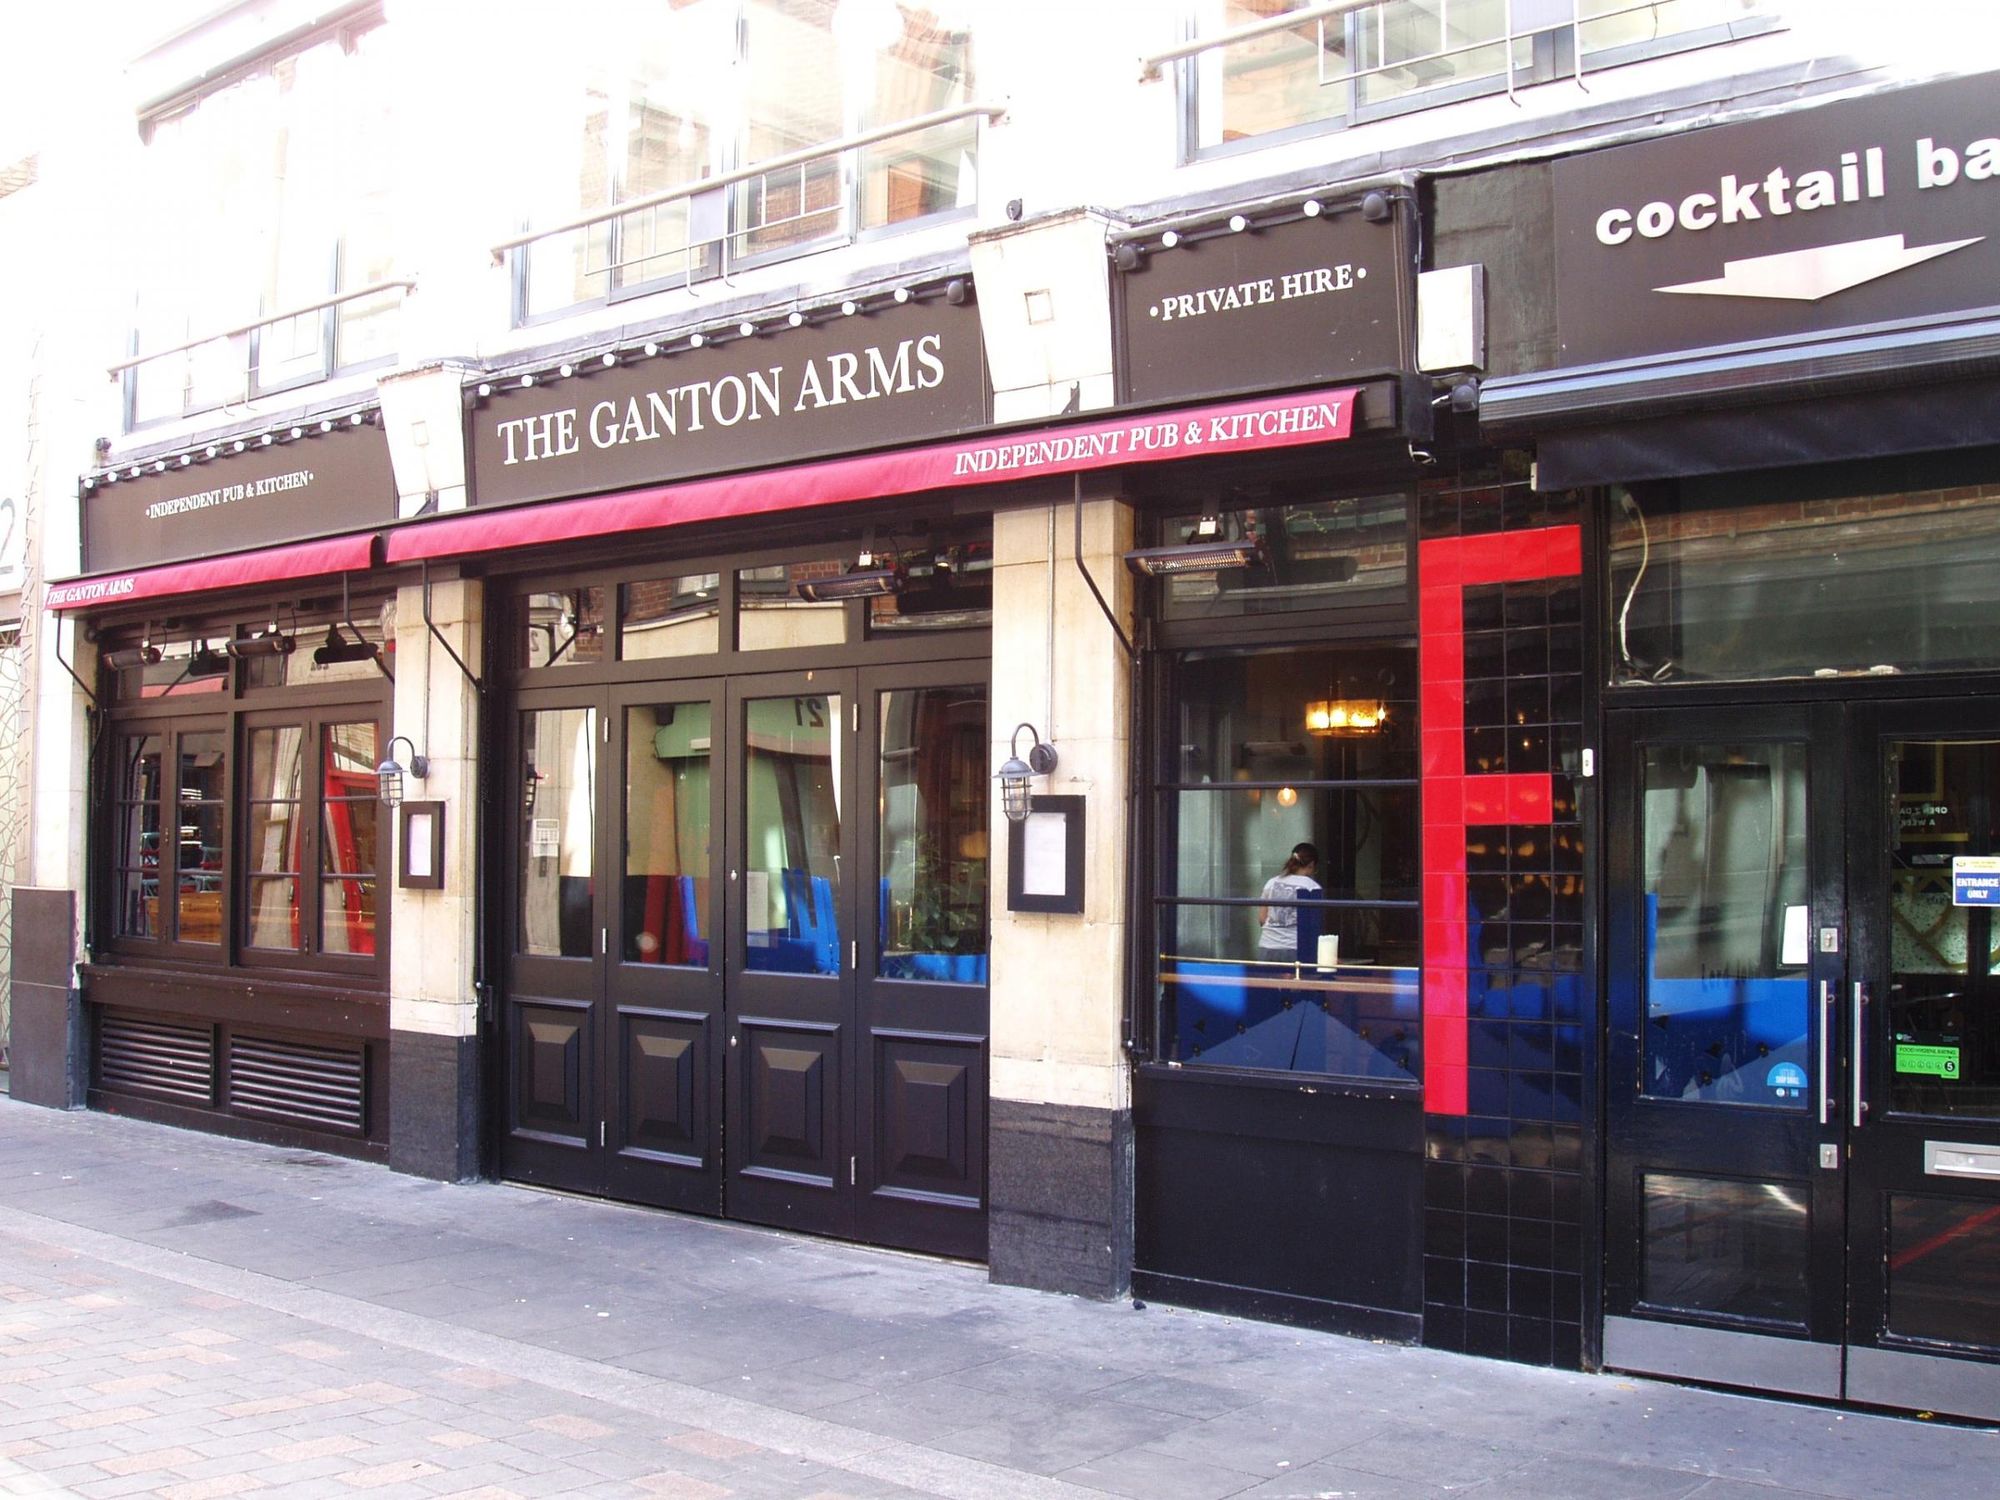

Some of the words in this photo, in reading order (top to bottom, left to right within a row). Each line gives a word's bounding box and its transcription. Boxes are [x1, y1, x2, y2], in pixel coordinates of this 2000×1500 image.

[1595, 147, 1885, 246] cocktail
[1162, 279, 1275, 321] PRIVATE
[1280, 264, 1353, 300] HIRE
[497, 408, 579, 465] THE
[589, 366, 783, 449] GANTON
[793, 333, 945, 412] ARMS
[953, 430, 1124, 476] INDEPENDENT
[1128, 424, 1178, 452] PUB
[1184, 421, 1203, 445] &
[1208, 402, 1341, 443] KITCHEN
[150, 489, 222, 519] INDEPENDENT
[222, 484, 244, 503] PUB
[246, 482, 254, 497] &
[256, 470, 309, 496] KITCHEN
[47, 589, 67, 605] THE
[66, 582, 108, 602] GANTON
[106, 577, 134, 595] ARMS
[1956, 877, 1999, 888] ENTRANCE
[1946, 1062, 1954, 1071] 5
